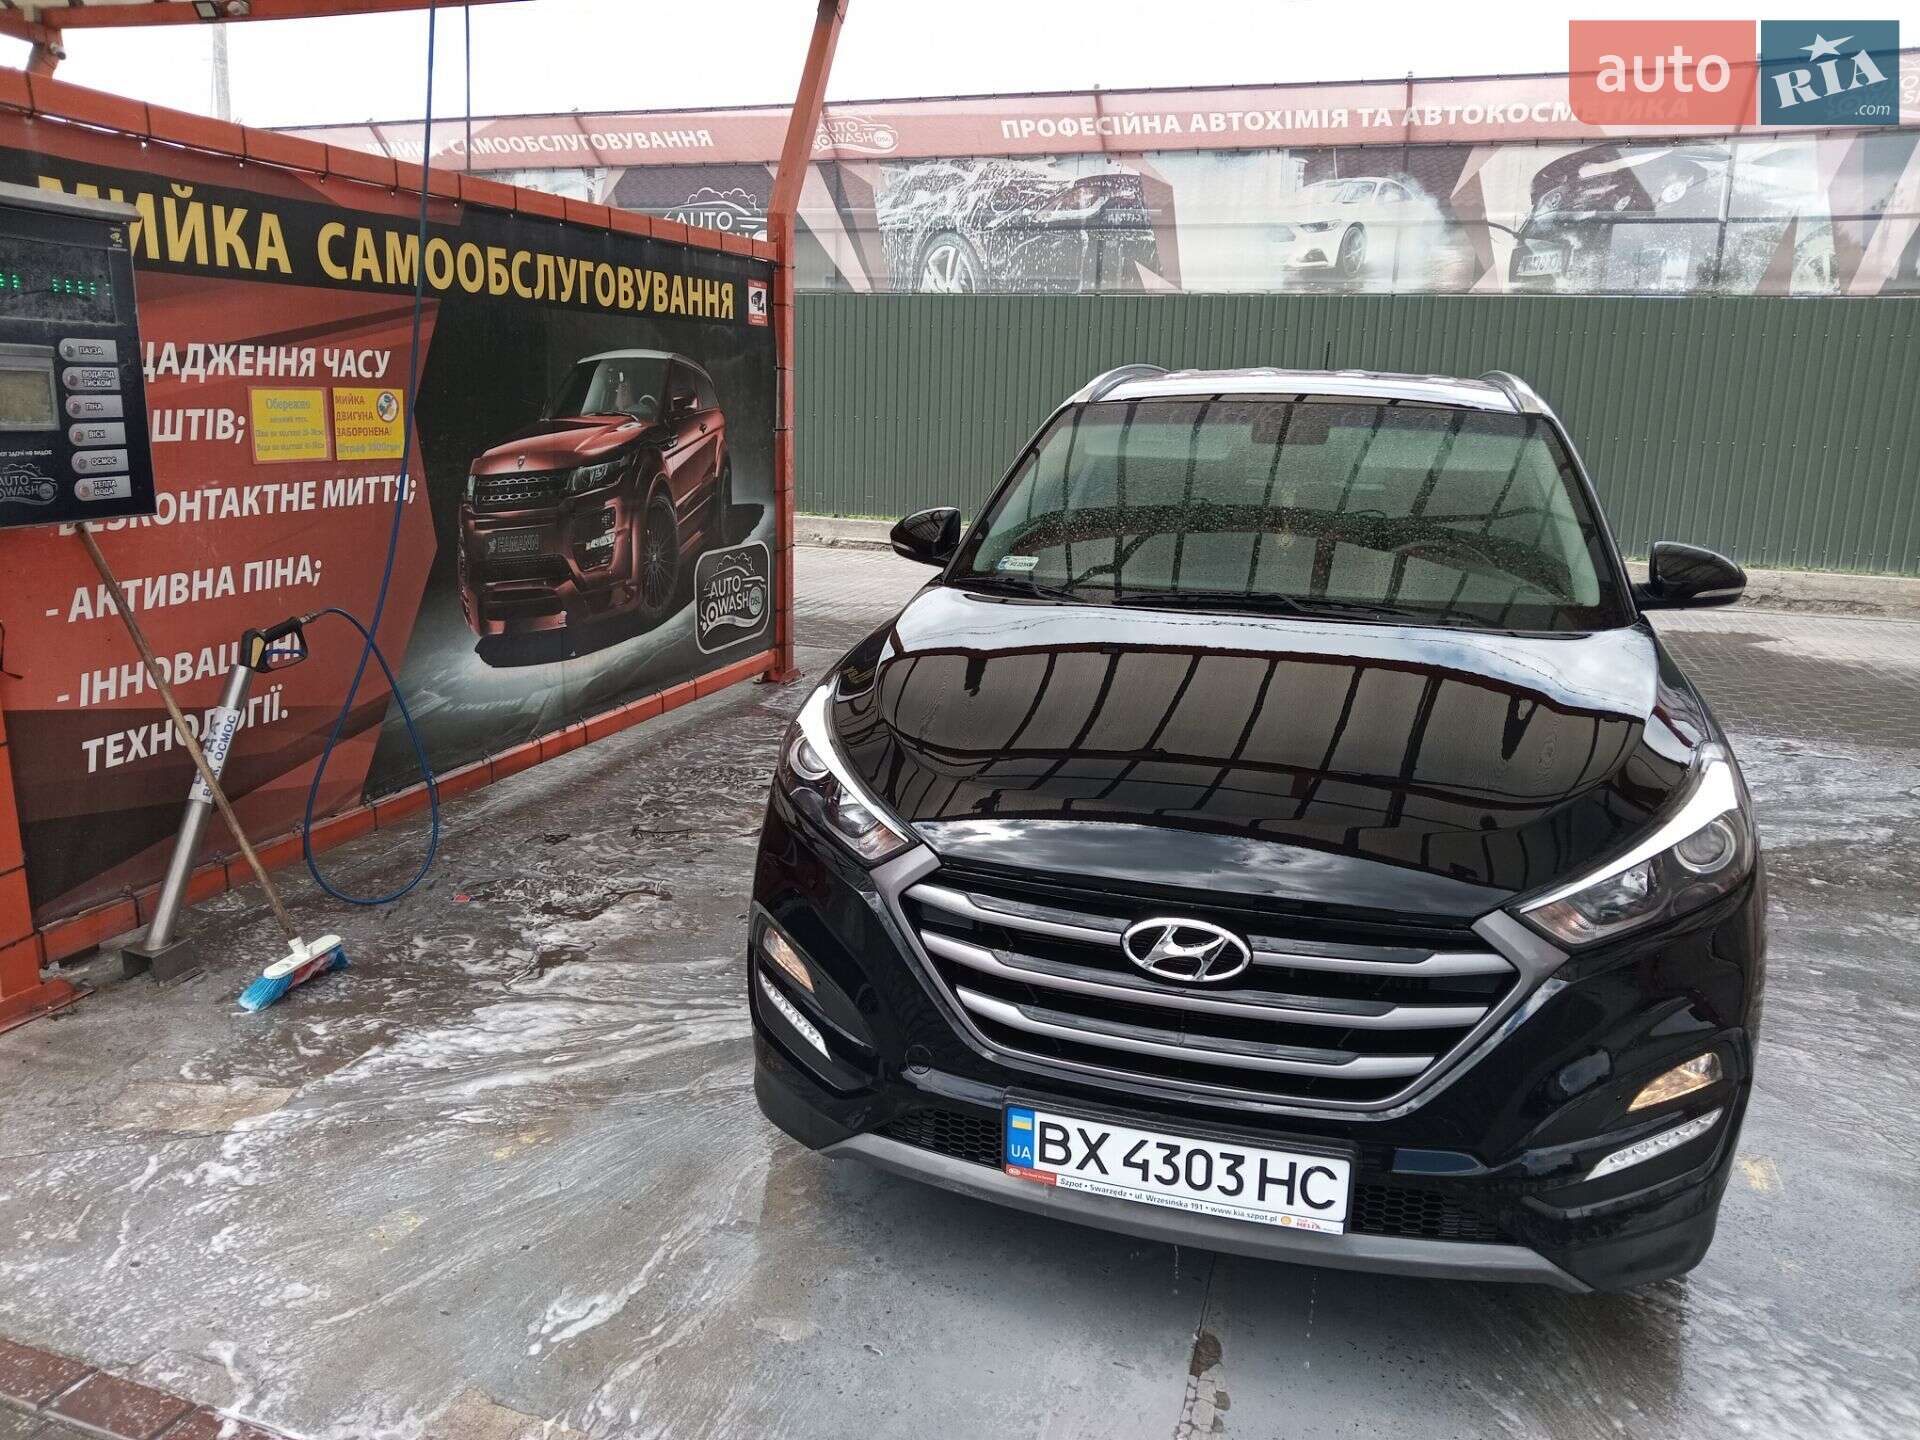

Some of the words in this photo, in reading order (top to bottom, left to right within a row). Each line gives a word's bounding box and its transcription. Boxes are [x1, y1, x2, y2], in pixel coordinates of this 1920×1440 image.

[817, 121, 859, 132] AUTO
[1000, 111, 1182, 139] ПРОФЕСІЙНА
[1190, 109, 1349, 132] АВТОХІМІЯ
[1358, 107, 1393, 128] ТА
[449, 129, 715, 156] САМООБСЛУГОВУВАННЯ
[676, 211, 733, 230] AUTO
[317, 221, 735, 321] САМООБСЛУГОВУВАННЯ
[323, 348, 392, 379] ЧАСУ
[335, 393, 366, 405] МИЙКА
[335, 411, 374, 422] ДВИГУНА
[322, 474, 417, 514] МИТТЯ;
[67, 567, 236, 623] АКТИВНА
[243, 554, 323, 593] ПІНА;
[709, 575, 741, 599] AUTO
[214, 714, 237, 761] ОСМОС
[1011, 1143, 1031, 1161] UA
[1038, 1120, 1111, 1175] BX
[1122, 1138, 1246, 1197] 4303
[1257, 1157, 1338, 1210] HC
[1060, 1177, 1082, 1189] Szpot
[1190, 1202, 1203, 1211] 191
